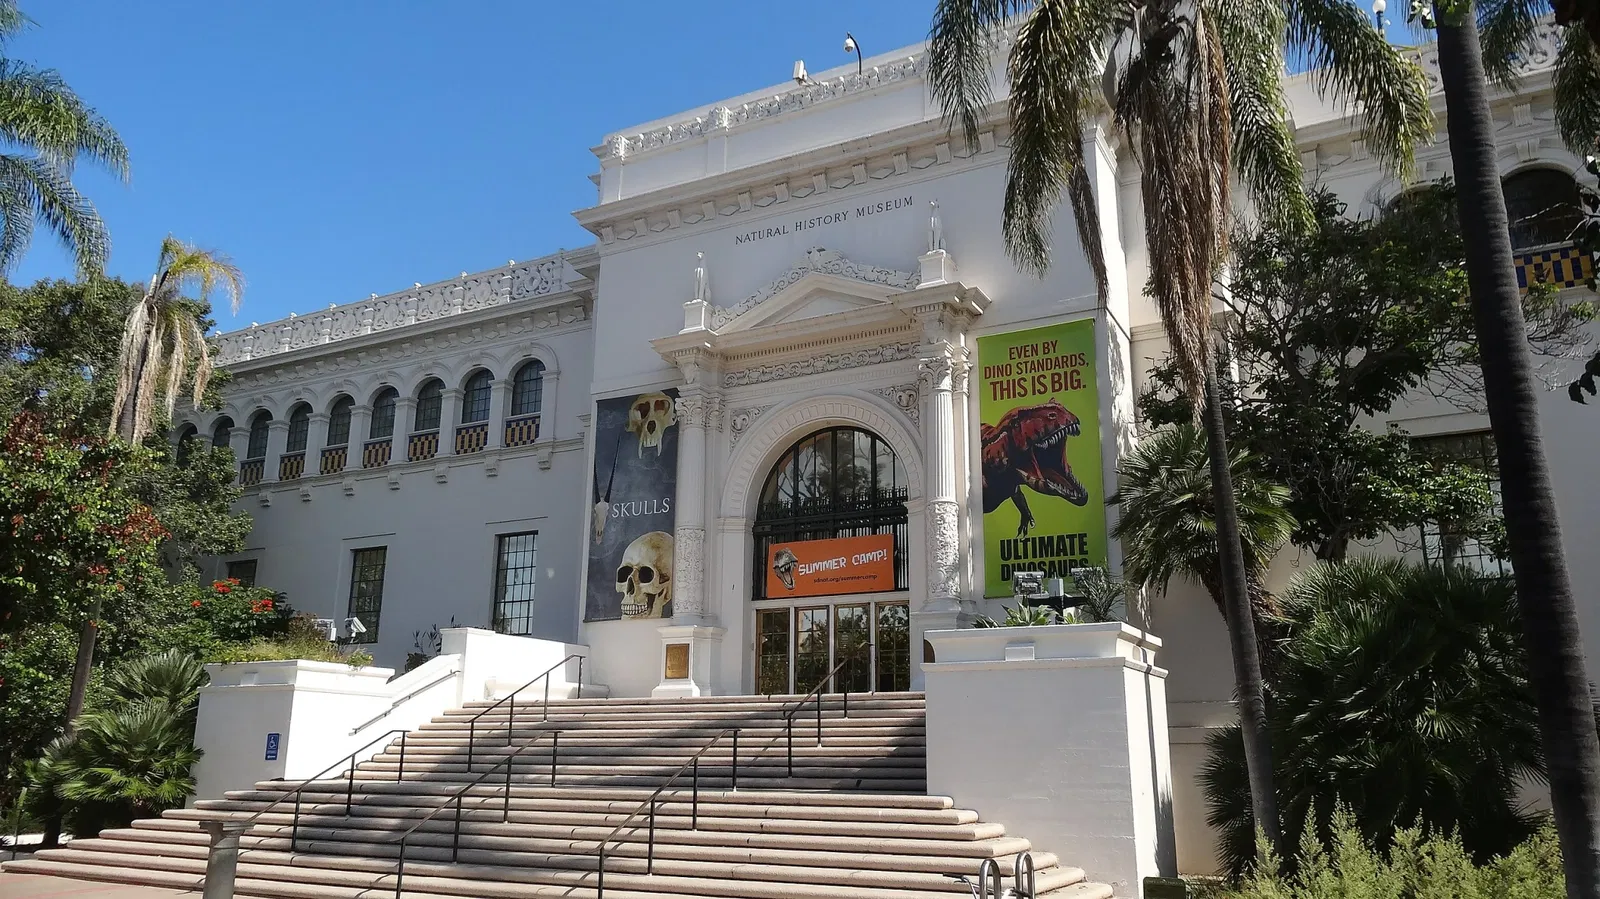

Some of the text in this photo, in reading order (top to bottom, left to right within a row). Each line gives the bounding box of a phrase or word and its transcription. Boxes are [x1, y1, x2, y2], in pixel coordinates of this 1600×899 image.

[735, 196, 914, 245] NATURAL HISTORY MUSEUM
[1009, 340, 1058, 360] EVEN BY
[984, 353, 1089, 379] DINO STANDARDS,
[990, 369, 1086, 401] THIS IS BIG.
[611, 497, 670, 518] SKULLS
[1000, 533, 1088, 561] ULTIMATE
[798, 548, 887, 576] SUMMER CAMP!
